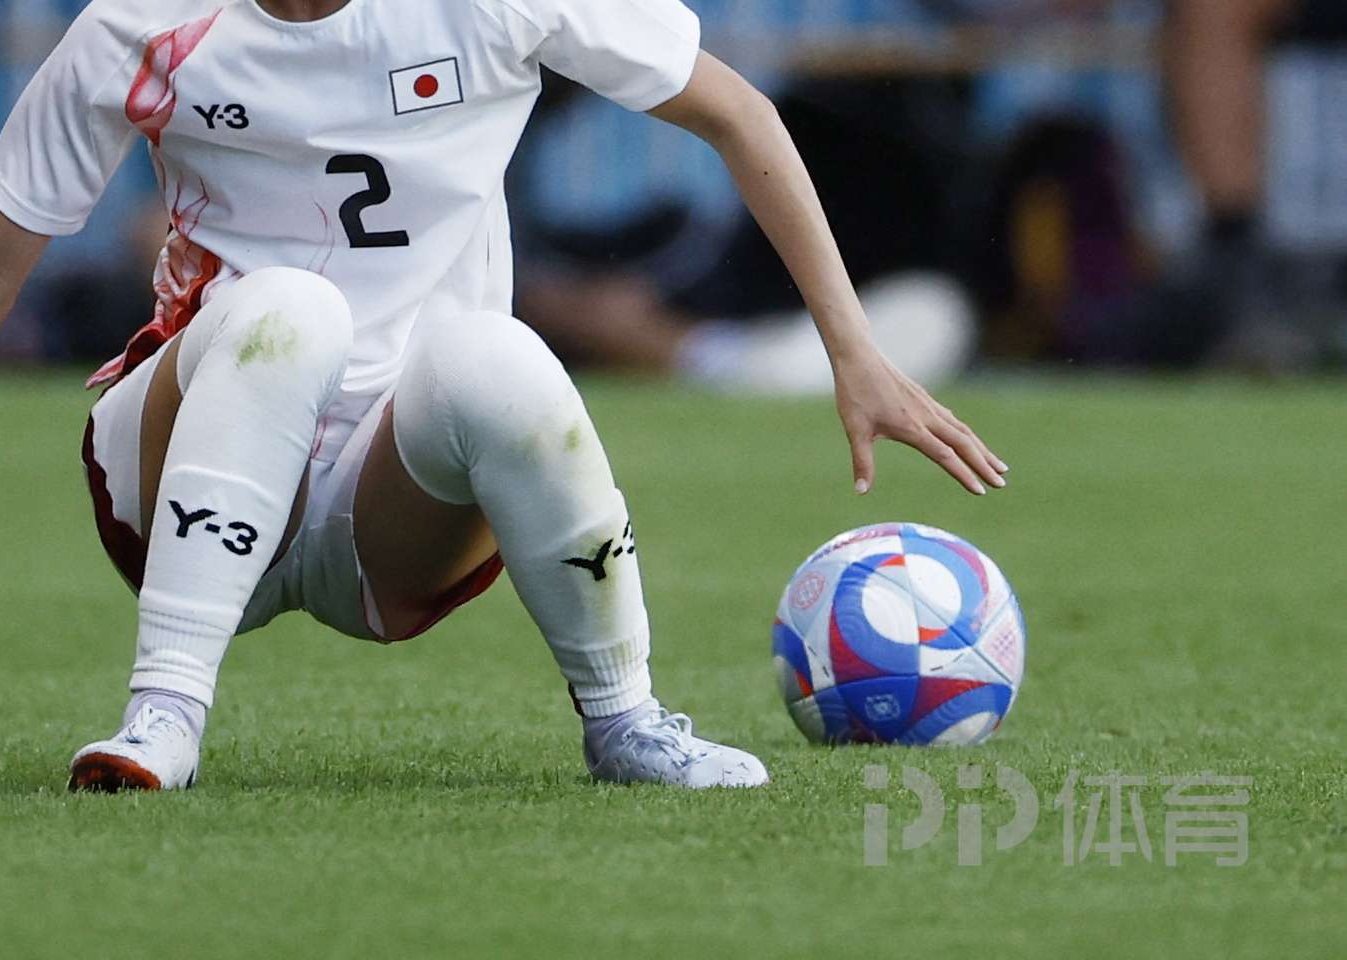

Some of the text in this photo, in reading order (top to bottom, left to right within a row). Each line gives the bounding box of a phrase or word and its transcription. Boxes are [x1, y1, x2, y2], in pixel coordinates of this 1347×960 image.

[192, 103, 250, 130] Y-3
[325, 153, 410, 249] 2
[167, 500, 259, 556] Y-3
